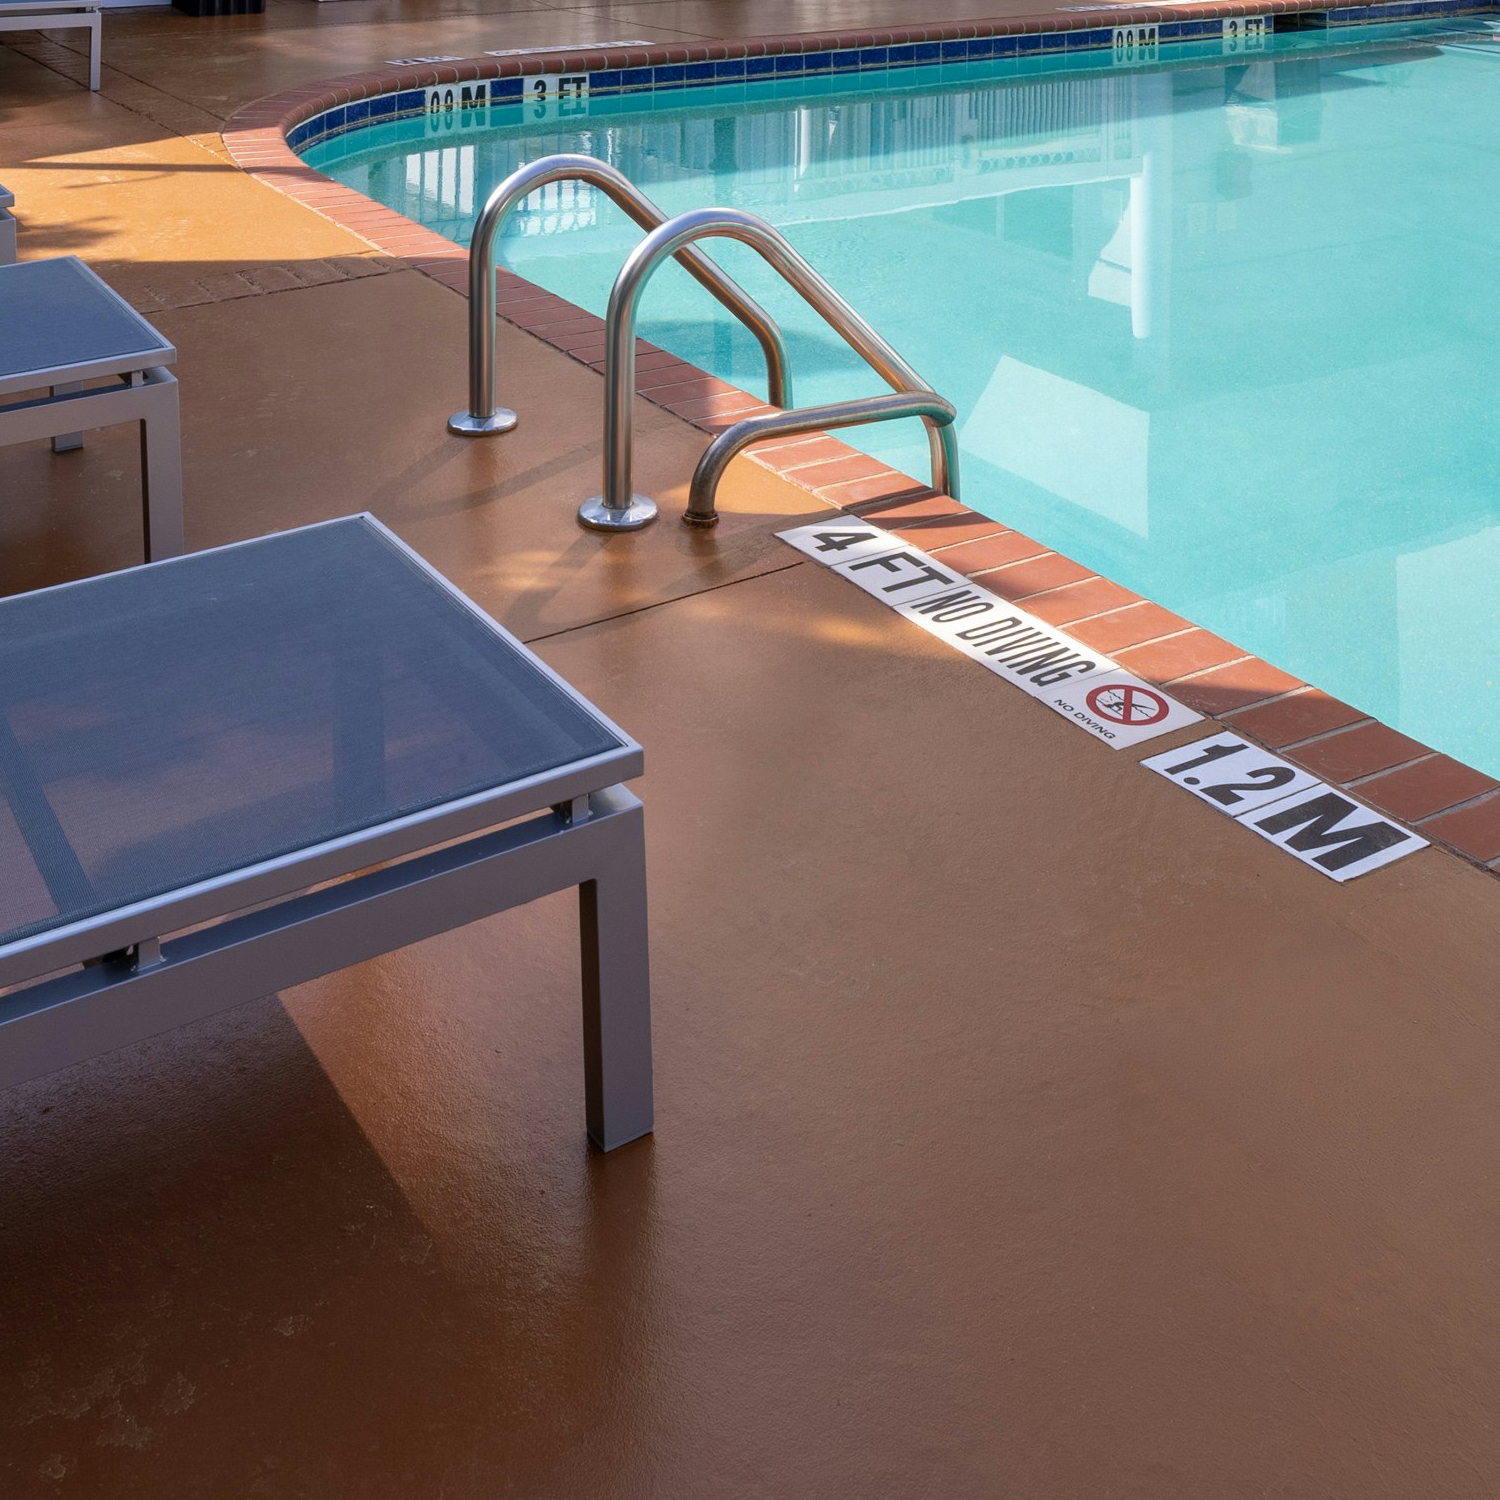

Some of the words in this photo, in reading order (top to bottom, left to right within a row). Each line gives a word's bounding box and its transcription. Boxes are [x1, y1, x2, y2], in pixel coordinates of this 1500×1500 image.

[1245, 18, 1263, 37] FT
[558, 76, 587, 100] FT
[812, 531, 875, 555] 4
[849, 550, 954, 593] FT
[919, 588, 995, 625] NO
[955, 616, 1096, 688] DIVING
[1053, 698, 1077, 714] NO
[1069, 708, 1117, 741] DIVING
[1164, 742, 1297, 807] 1.2
[1255, 791, 1411, 873] M
